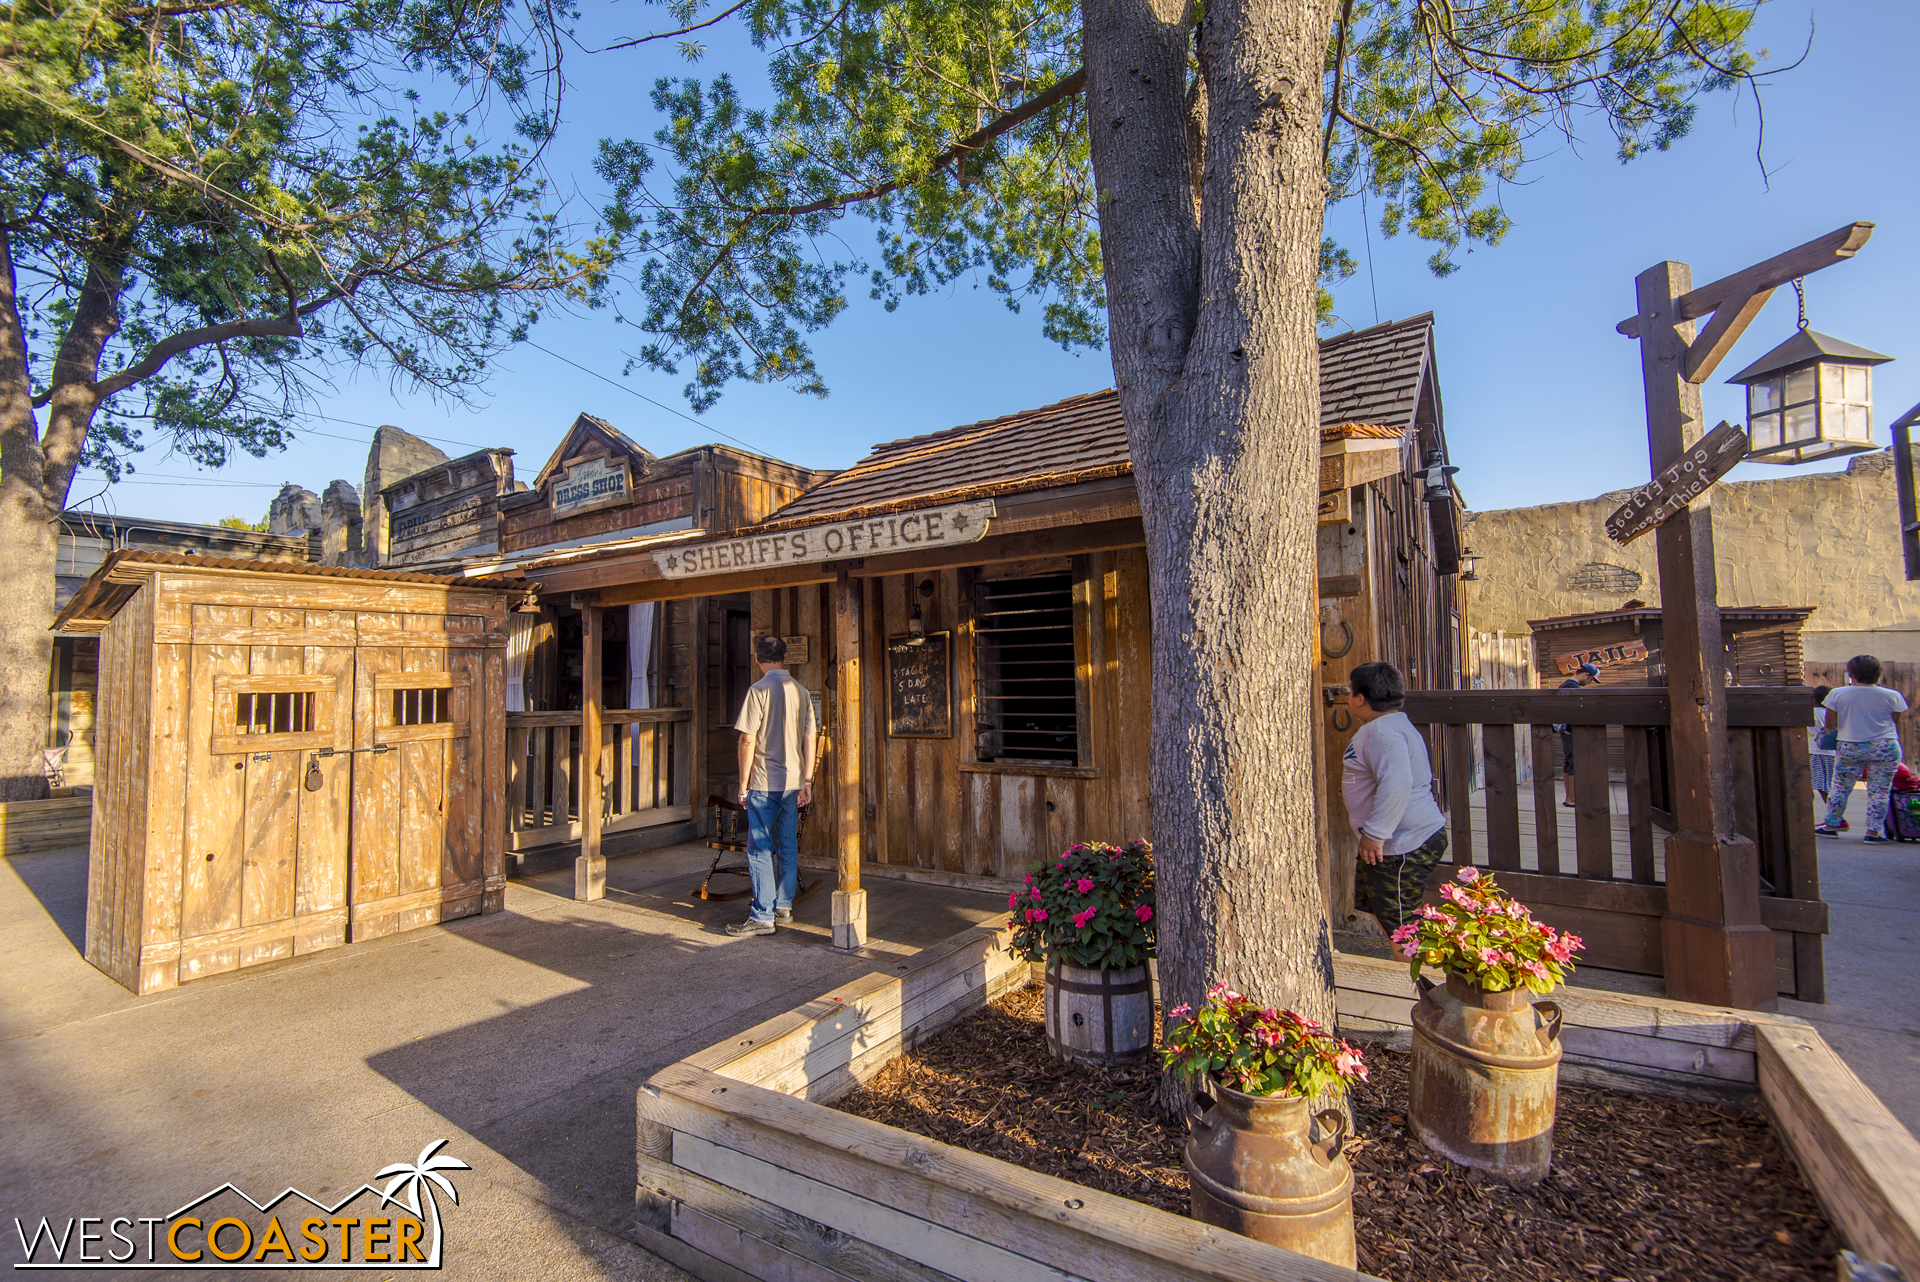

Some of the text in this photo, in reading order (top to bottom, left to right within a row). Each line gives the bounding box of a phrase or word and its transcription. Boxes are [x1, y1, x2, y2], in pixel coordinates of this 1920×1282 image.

[1666, 449, 1709, 483] Joe
[556, 473, 624, 505] DRESS SHOP
[1665, 468, 1711, 510] Thief
[682, 512, 946, 573] SHERIFFS OFFICE
[893, 664, 923, 679] STAGE
[1567, 645, 1637, 672] JAIL
[904, 694, 926, 705] LATE
